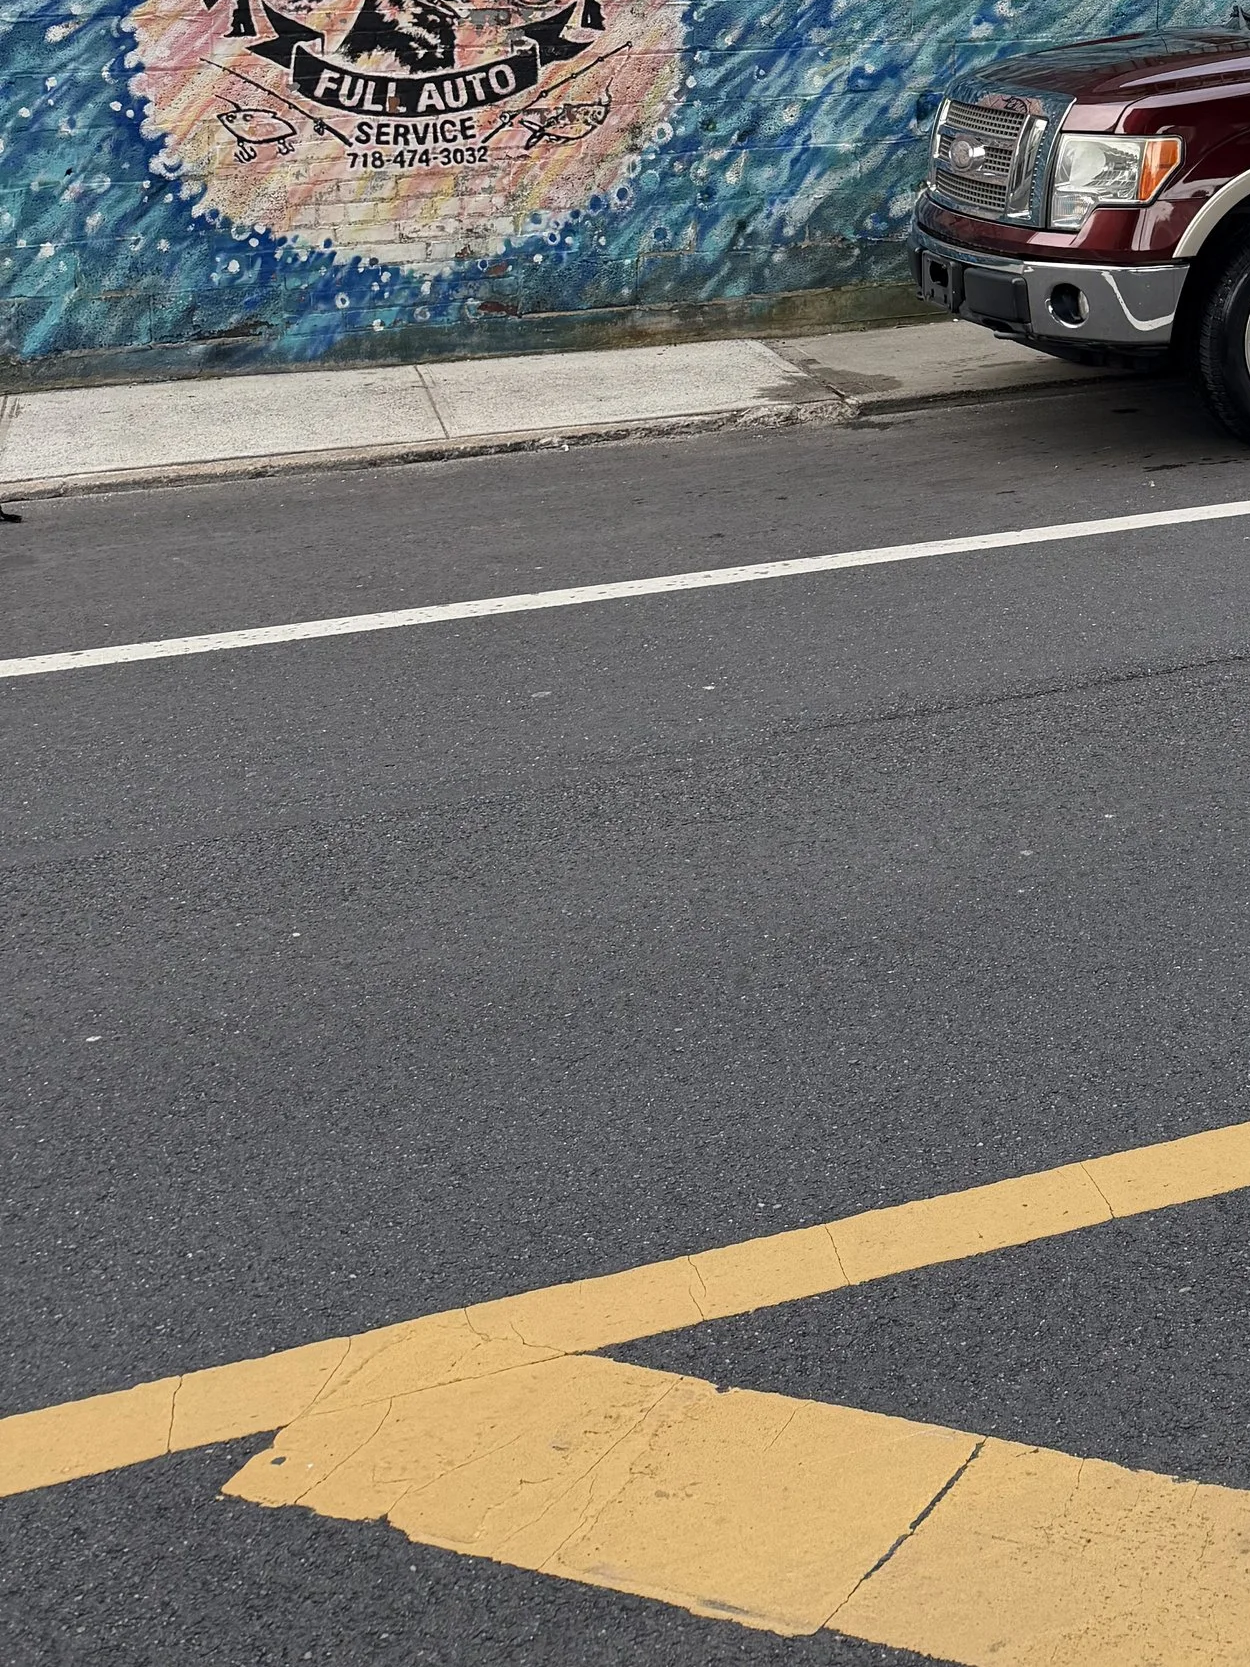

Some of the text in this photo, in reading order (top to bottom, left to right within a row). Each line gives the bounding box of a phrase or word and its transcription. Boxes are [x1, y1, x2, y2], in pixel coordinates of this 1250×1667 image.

[314, 64, 516, 113] FULL AUTO
[354, 117, 477, 146] SERVICE
[346, 146, 488, 169] 718-474-3032
